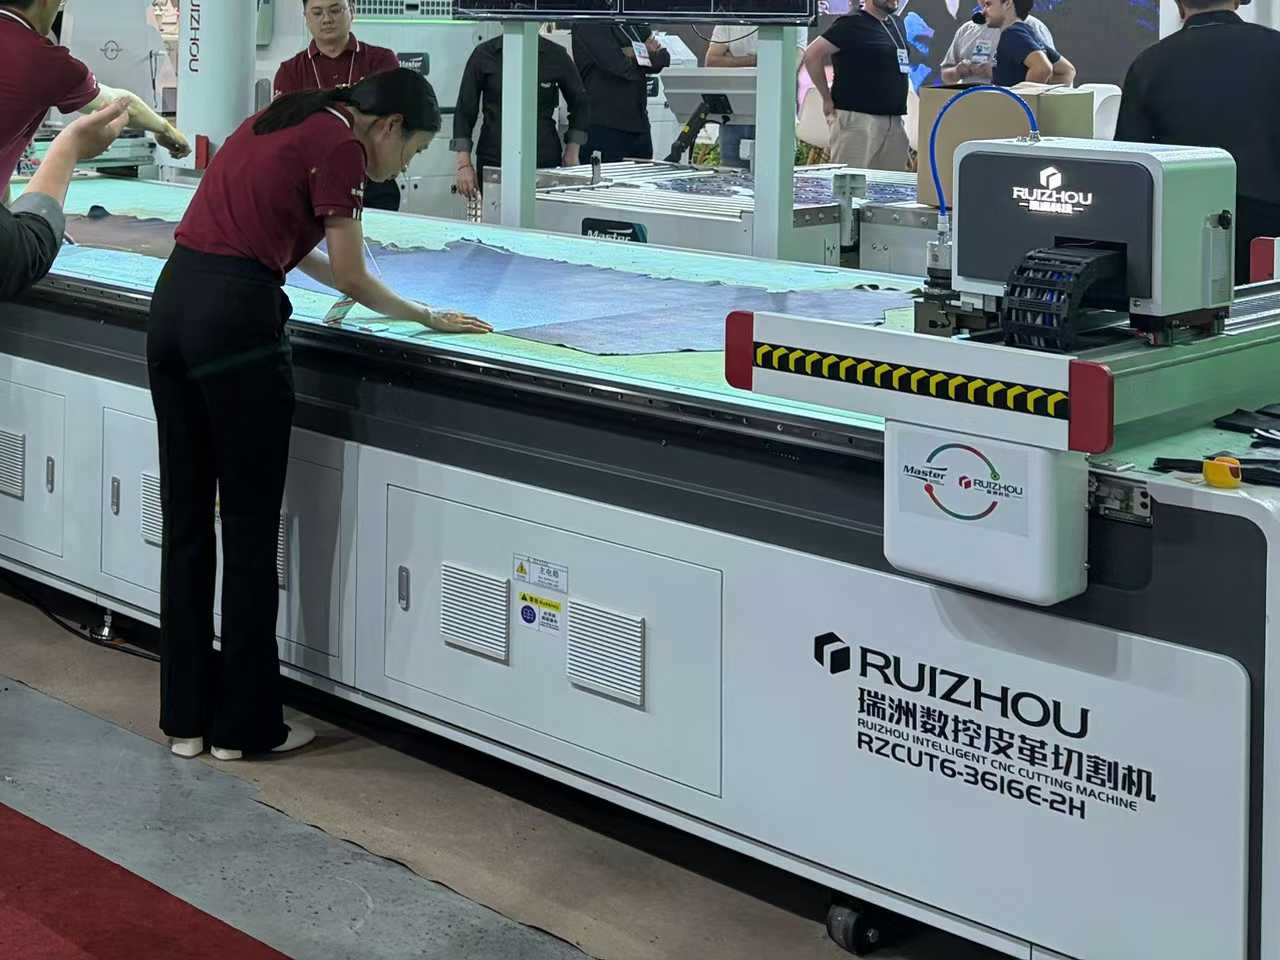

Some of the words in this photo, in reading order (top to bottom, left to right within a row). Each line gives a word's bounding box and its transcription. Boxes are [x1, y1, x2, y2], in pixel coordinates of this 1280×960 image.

[1012, 186, 1093, 205] RUIZHOU
[903, 464, 946, 480] Master
[973, 478, 1023, 496] RUIZHOU
[859, 646, 1091, 739] RUIZHOU
[857, 686, 1157, 802] 瑞洲数控皮革切割机
[857, 718, 910, 742] RUIZHOU
[912, 732, 987, 766] INTELLIGENT
[990, 759, 1016, 775] CNC
[1018, 767, 1073, 792] CUTTING
[1076, 784, 1138, 811] MACHINE
[857, 732, 1086, 820] RZCUT6-3616E-2H
